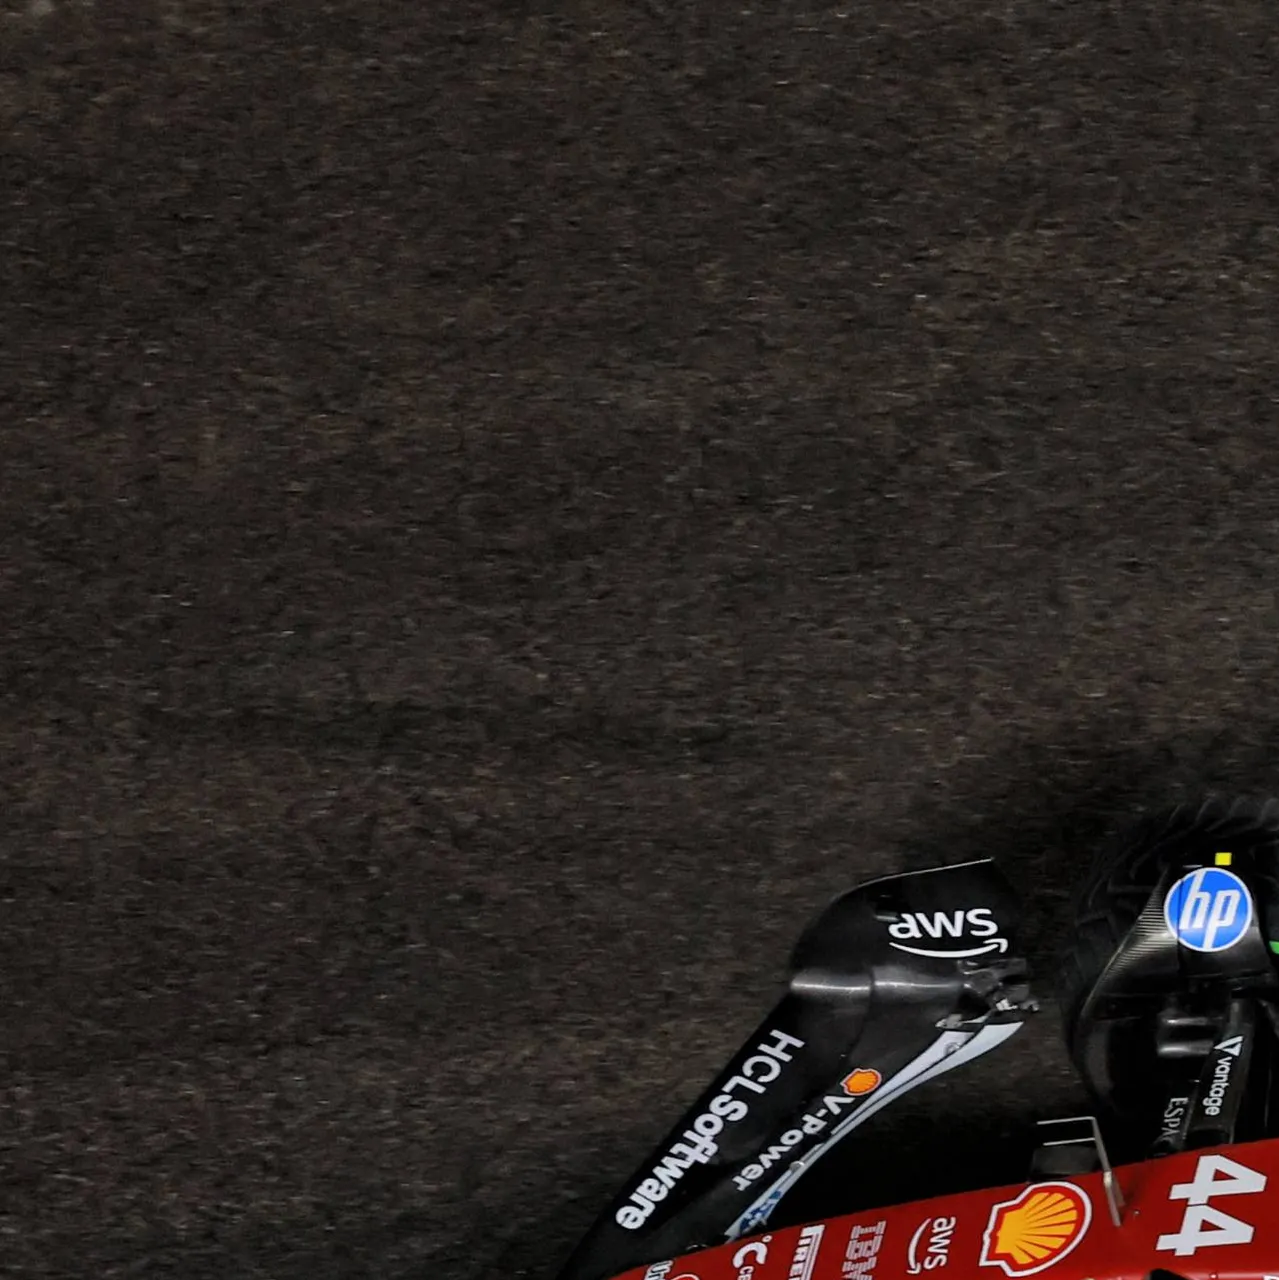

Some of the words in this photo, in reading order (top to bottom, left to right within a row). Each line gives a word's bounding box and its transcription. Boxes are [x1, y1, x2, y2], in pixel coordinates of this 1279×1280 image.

[888, 907, 998, 938] aws
[1176, 868, 1246, 952] hp
[1203, 1056, 1232, 1116] vantage
[615, 1029, 805, 1230] HCLSoftware
[733, 1093, 856, 1192] V-Power
[923, 1216, 956, 1270] aws
[1156, 1154, 1267, 1256] 44
